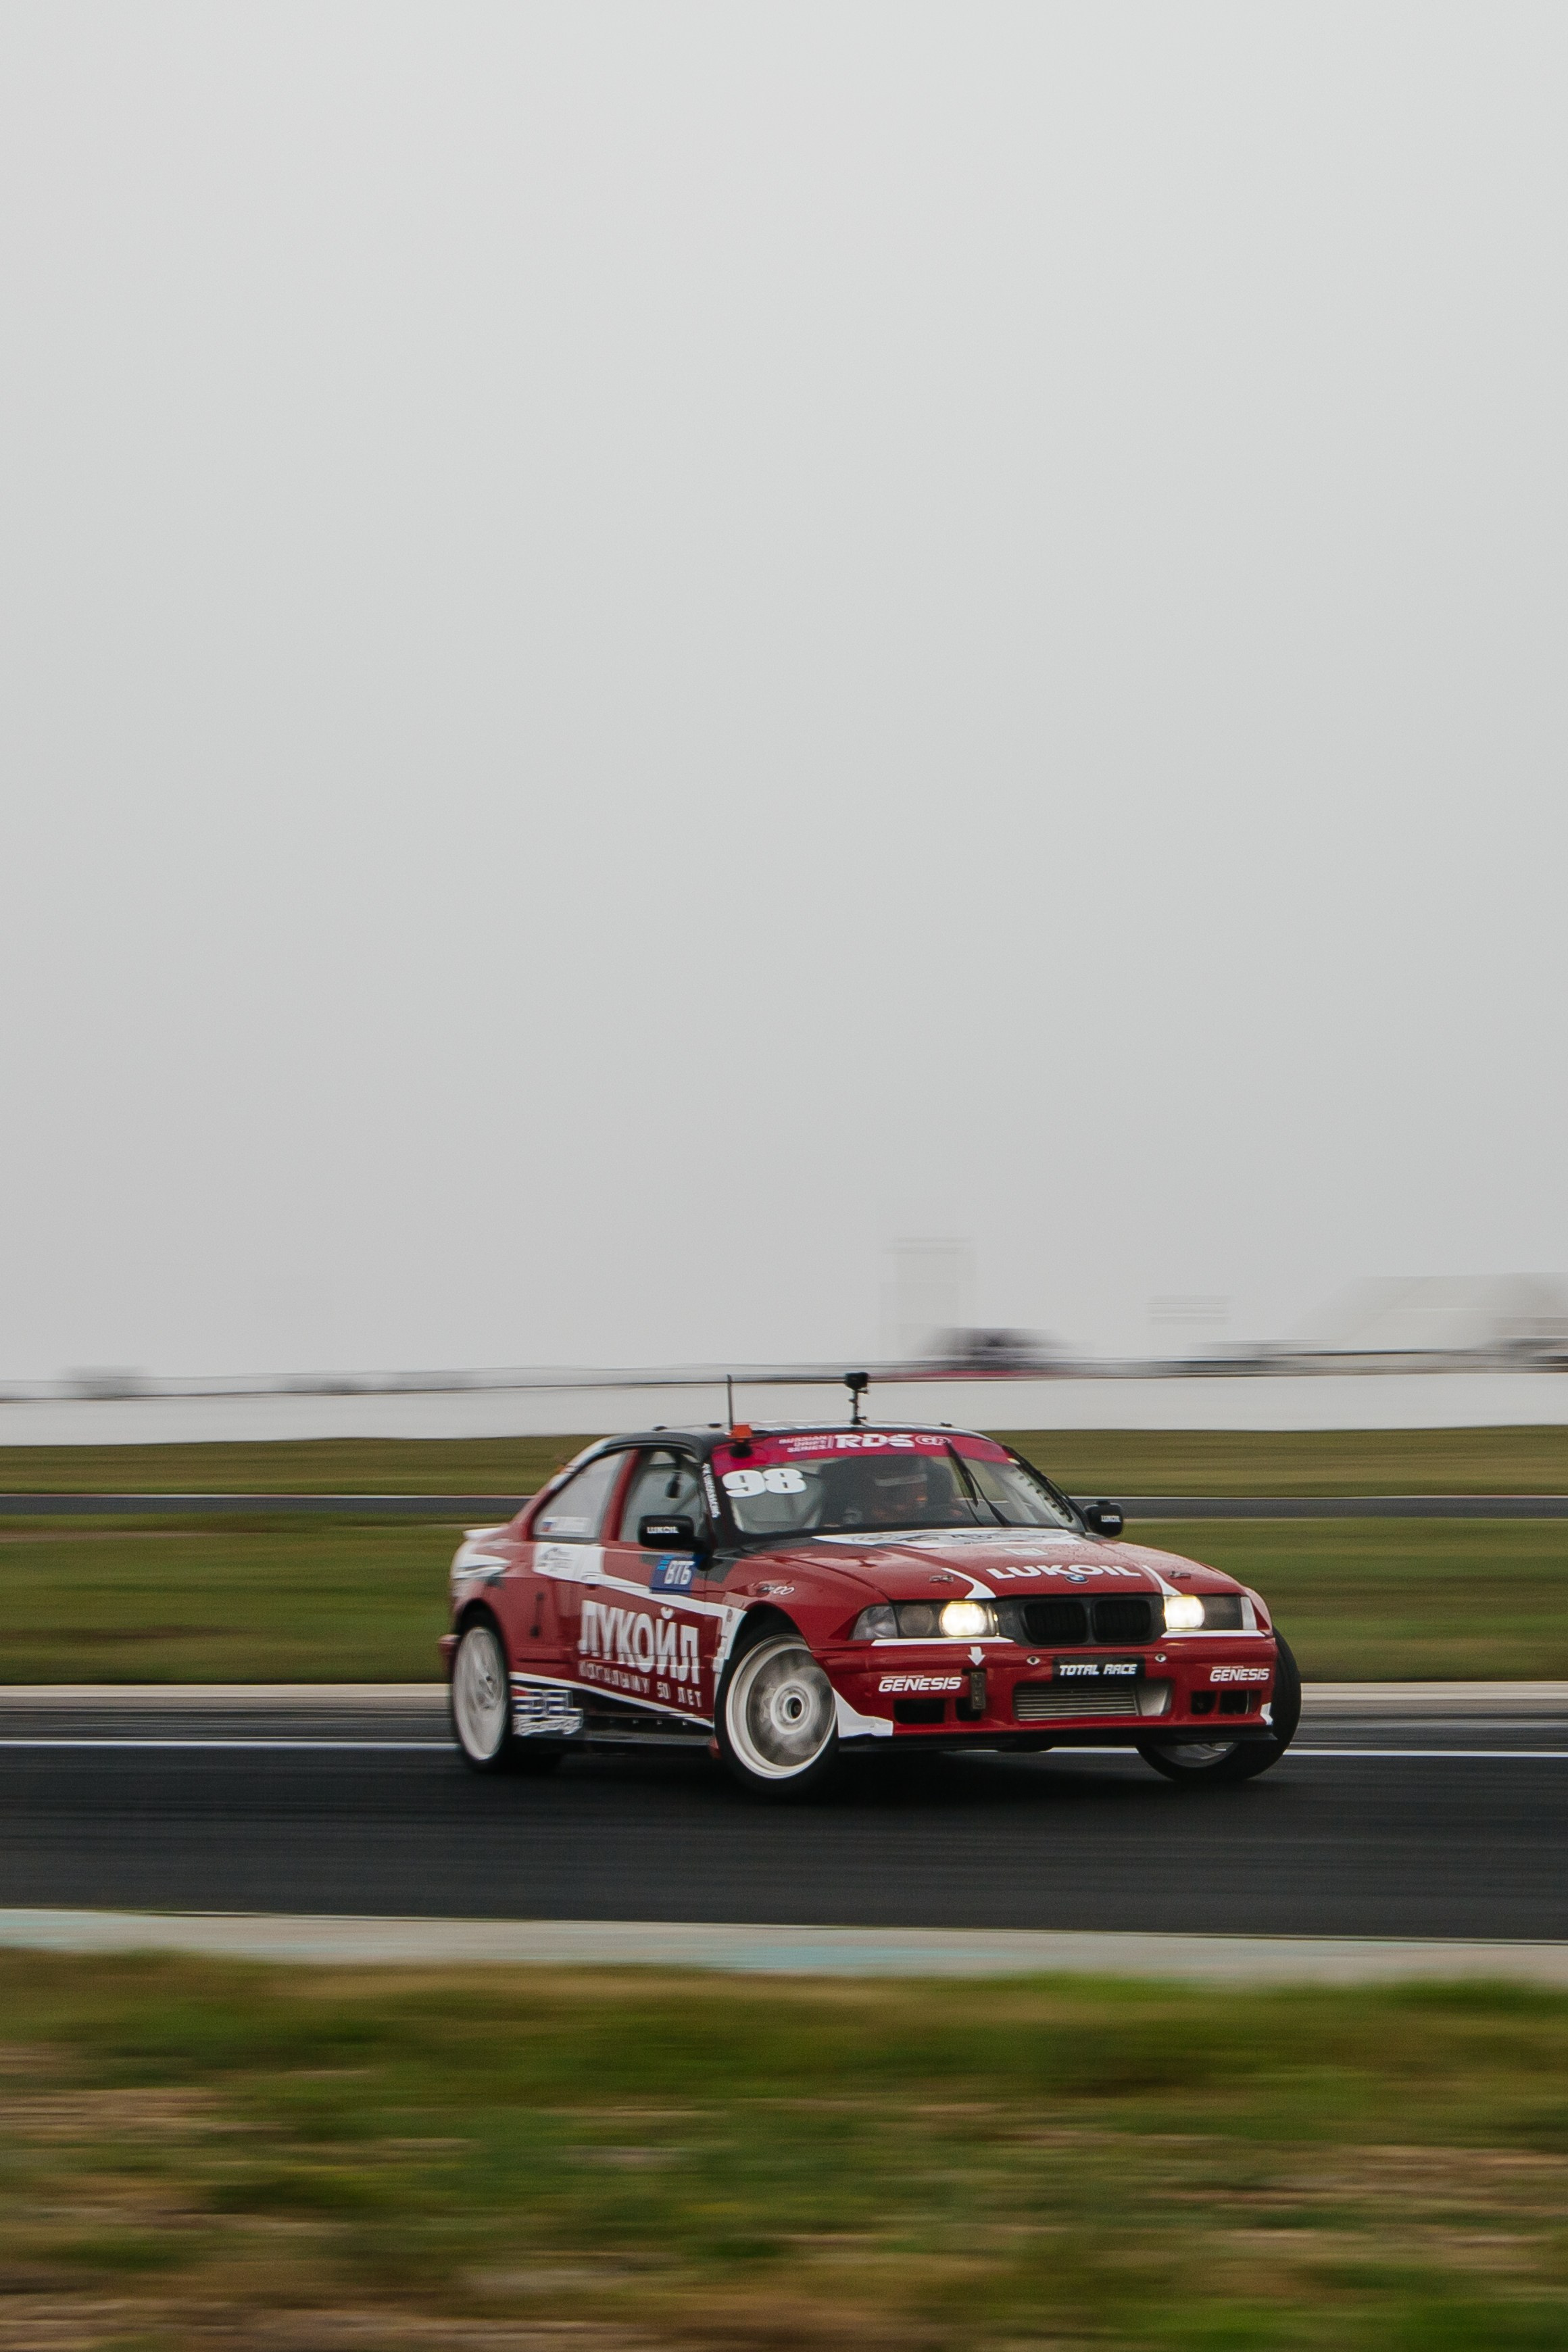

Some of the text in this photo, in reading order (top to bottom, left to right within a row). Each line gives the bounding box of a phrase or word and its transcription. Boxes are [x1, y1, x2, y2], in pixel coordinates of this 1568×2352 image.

[835, 1434, 951, 1448] RDS GP
[787, 1445, 827, 1453] SERIES
[722, 1468, 807, 1498] 98
[664, 1560, 696, 1585] ВТБ
[985, 1565, 1142, 1579] LUKOIL
[578, 1600, 700, 1684] ЛУКОЙЛ
[1059, 1663, 1138, 1676] TOTAL RACE
[1210, 1668, 1270, 1682] GENESIS
[879, 1677, 962, 1692] GENESIS
[678, 1686, 702, 1707] ЛЕТ
